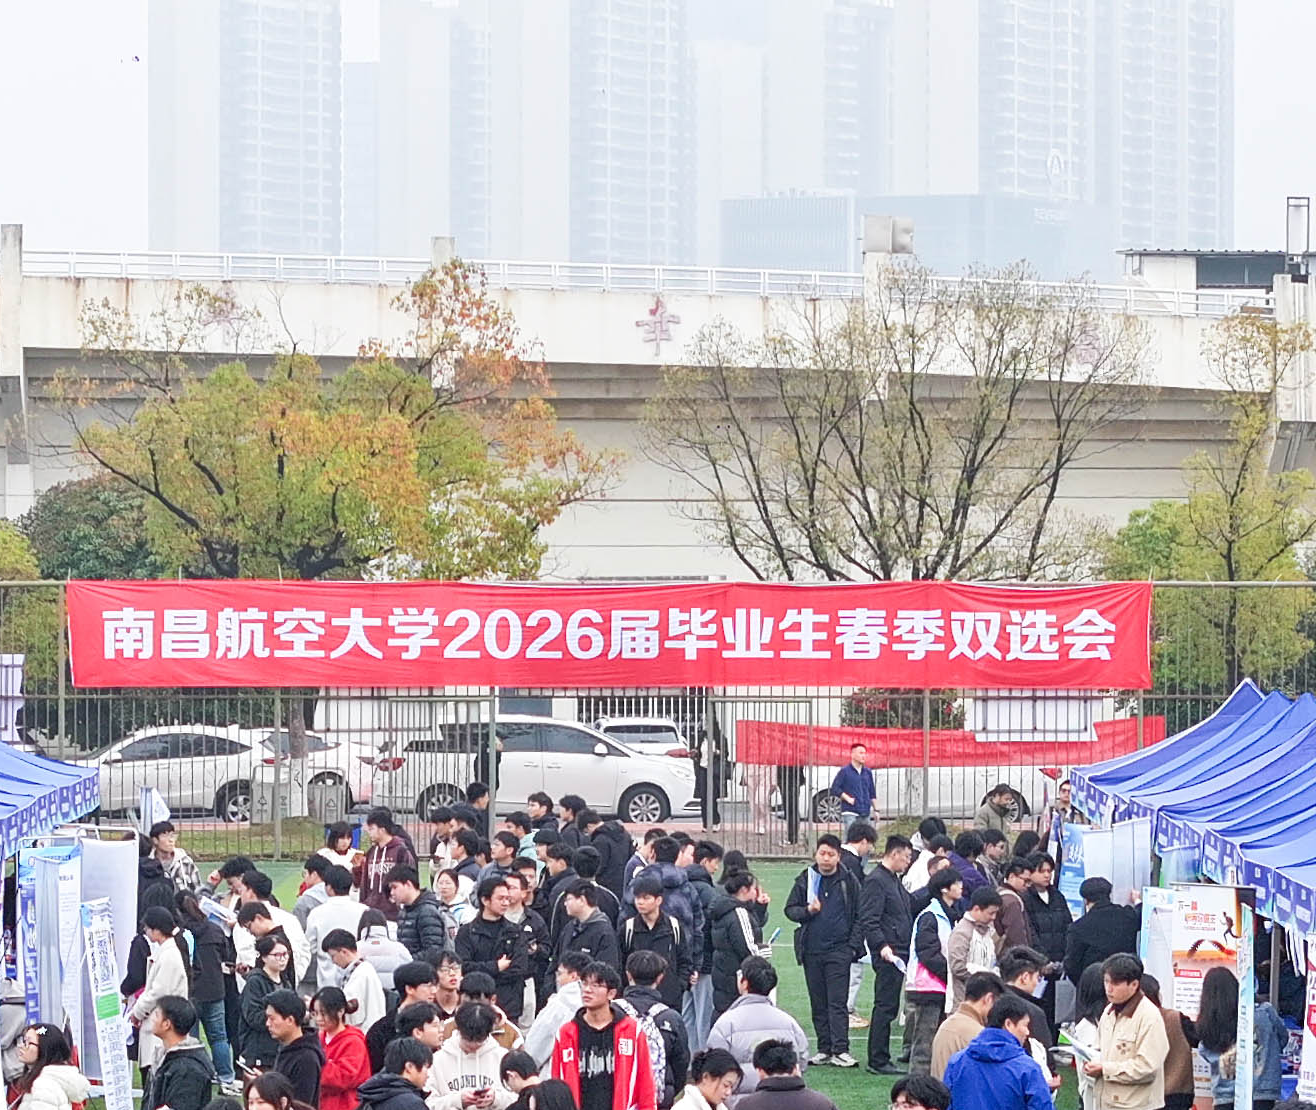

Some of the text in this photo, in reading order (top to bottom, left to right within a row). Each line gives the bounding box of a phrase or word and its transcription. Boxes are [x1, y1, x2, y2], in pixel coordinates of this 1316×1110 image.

[102, 606, 1117, 663] 南昌航空大学2026届毕业生春季双选会
